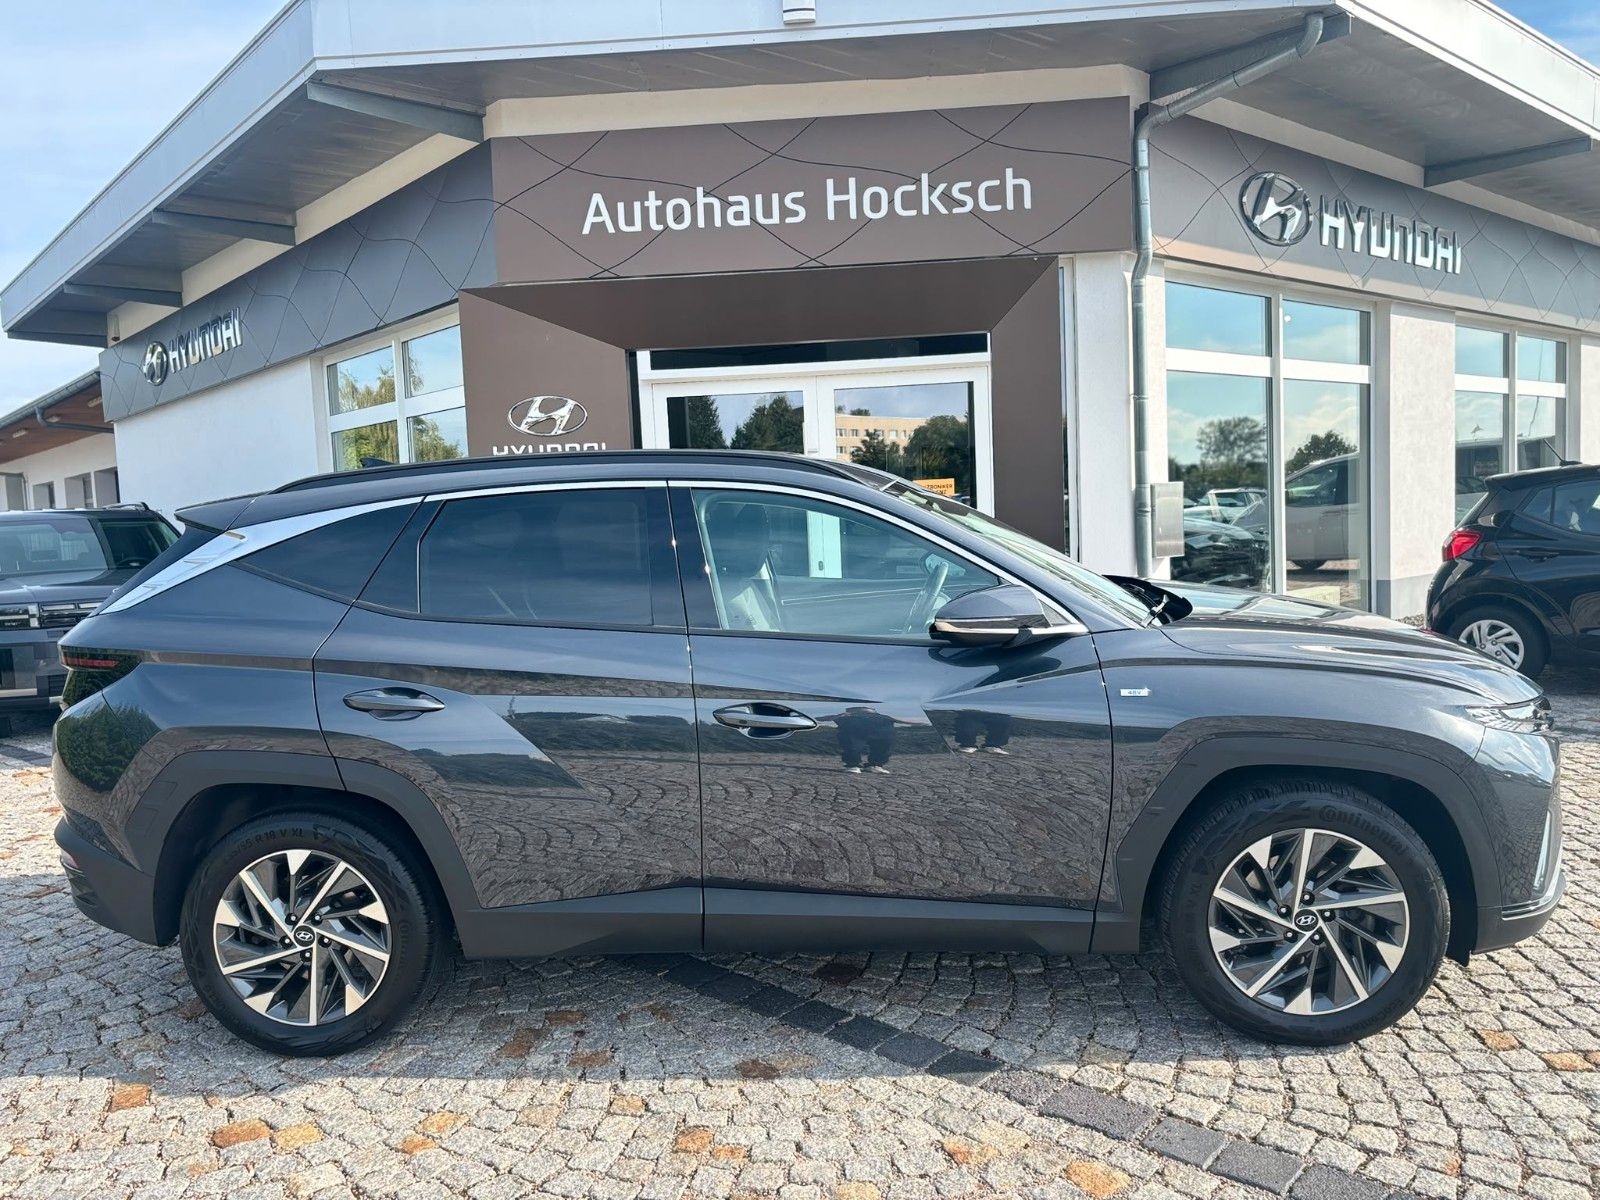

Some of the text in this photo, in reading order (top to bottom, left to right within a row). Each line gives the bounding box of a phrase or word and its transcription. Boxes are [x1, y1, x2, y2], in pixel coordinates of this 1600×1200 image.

[582, 168, 1032, 234] Autohaus Hocksch
[1319, 194, 1462, 274] HYUNDAI
[168, 307, 243, 374] HYUNDAI
